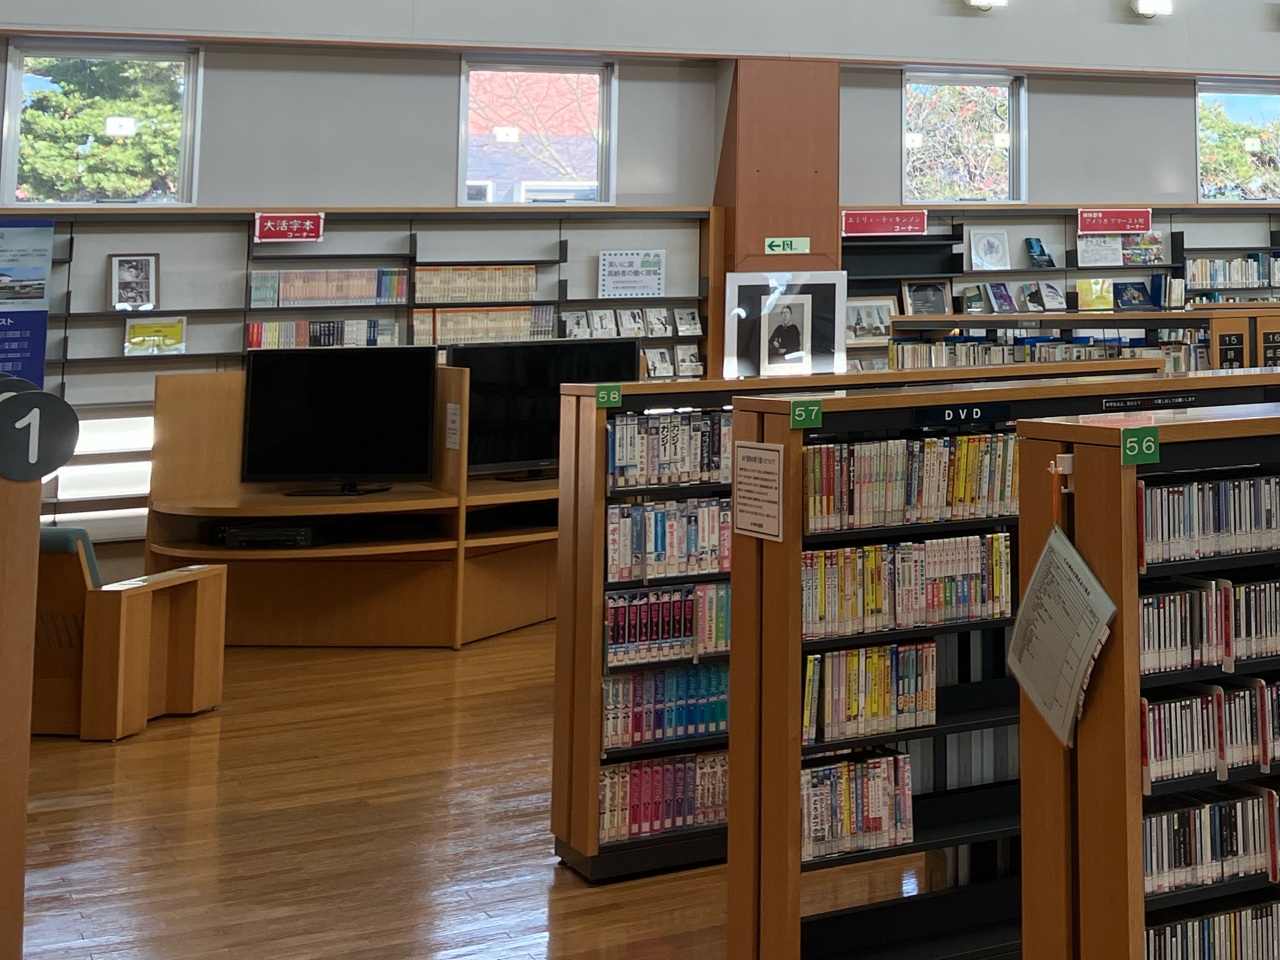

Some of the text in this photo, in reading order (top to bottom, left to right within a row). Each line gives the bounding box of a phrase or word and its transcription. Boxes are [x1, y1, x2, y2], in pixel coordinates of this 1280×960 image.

[264, 220, 314, 231] 大活字本
[1225, 335, 1237, 344] 15
[1268, 334, 1280, 342] 16
[598, 390, 619, 402] 58
[794, 406, 819, 421] 57
[945, 408, 981, 421] DVD
[14, 407, 41, 464] 1
[1125, 435, 1155, 456] 56
